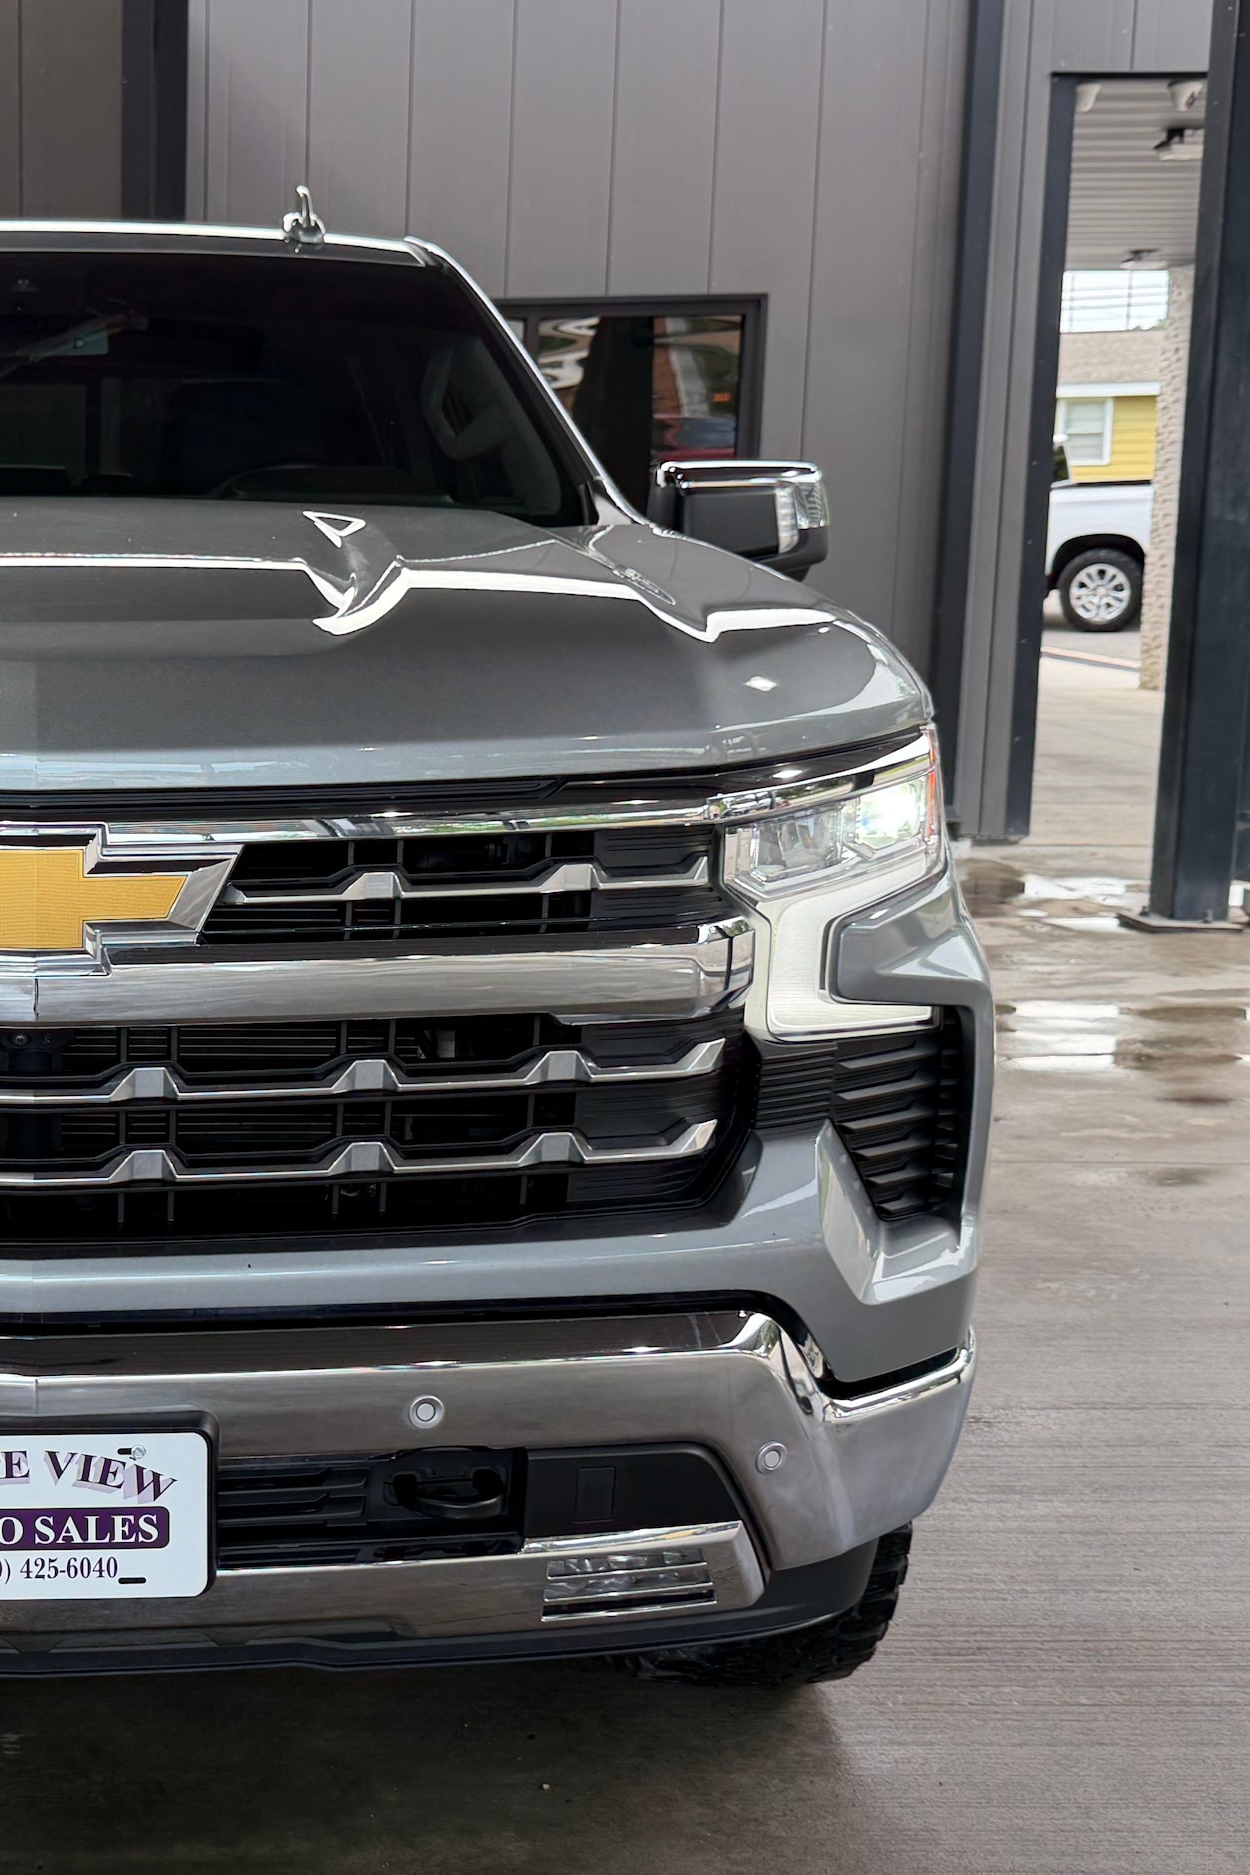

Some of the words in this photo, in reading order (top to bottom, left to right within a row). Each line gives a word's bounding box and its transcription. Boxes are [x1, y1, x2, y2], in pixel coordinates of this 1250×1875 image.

[44, 1450, 178, 1504] VIEW
[34, 1514, 159, 1545] SALES
[20, 1556, 118, 1580] 425-6040
